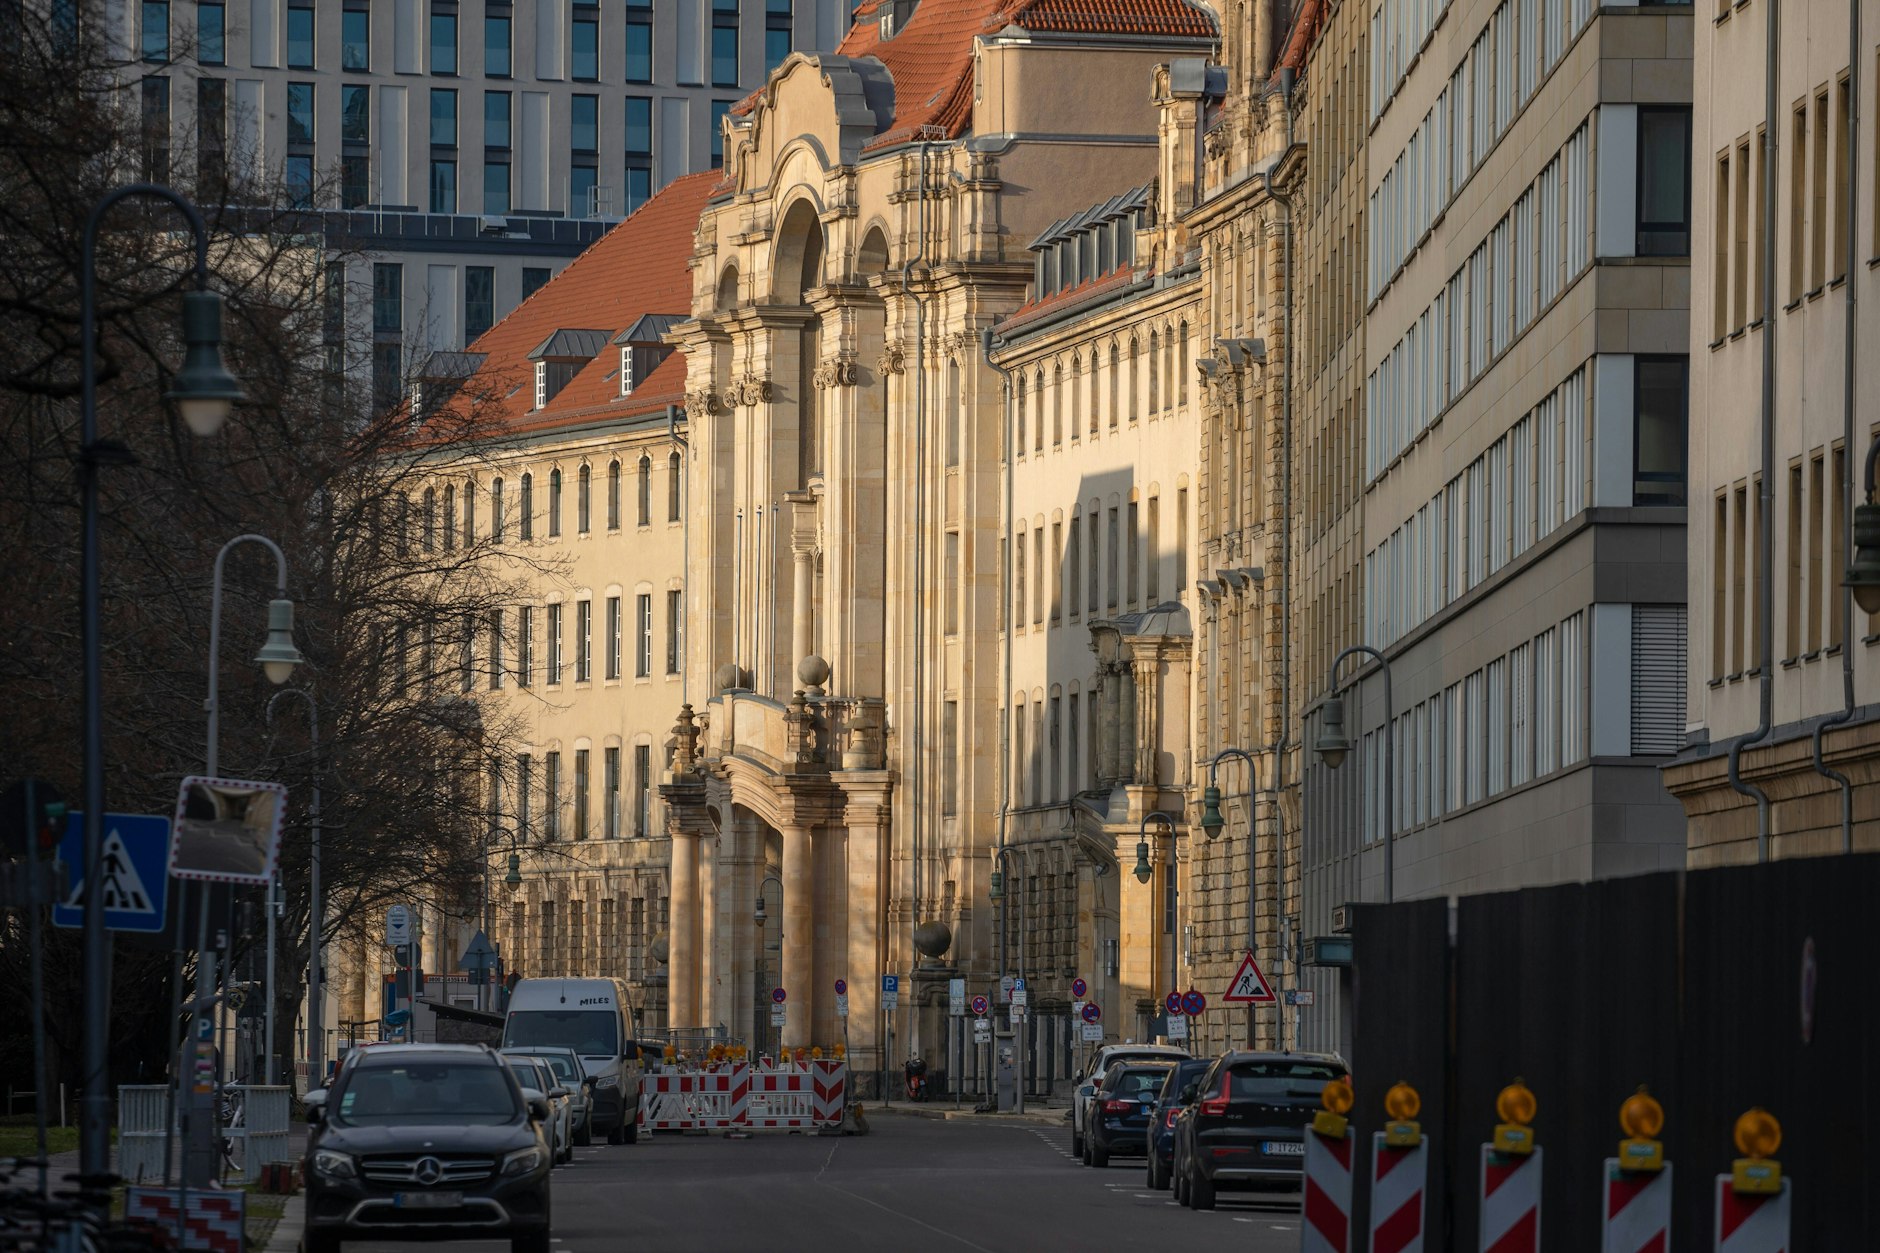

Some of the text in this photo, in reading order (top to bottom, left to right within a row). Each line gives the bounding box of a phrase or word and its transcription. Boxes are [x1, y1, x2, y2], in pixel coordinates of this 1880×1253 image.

[883, 977, 895, 990] P
[580, 997, 610, 1006] MILES
[198, 1018, 212, 1038] P
